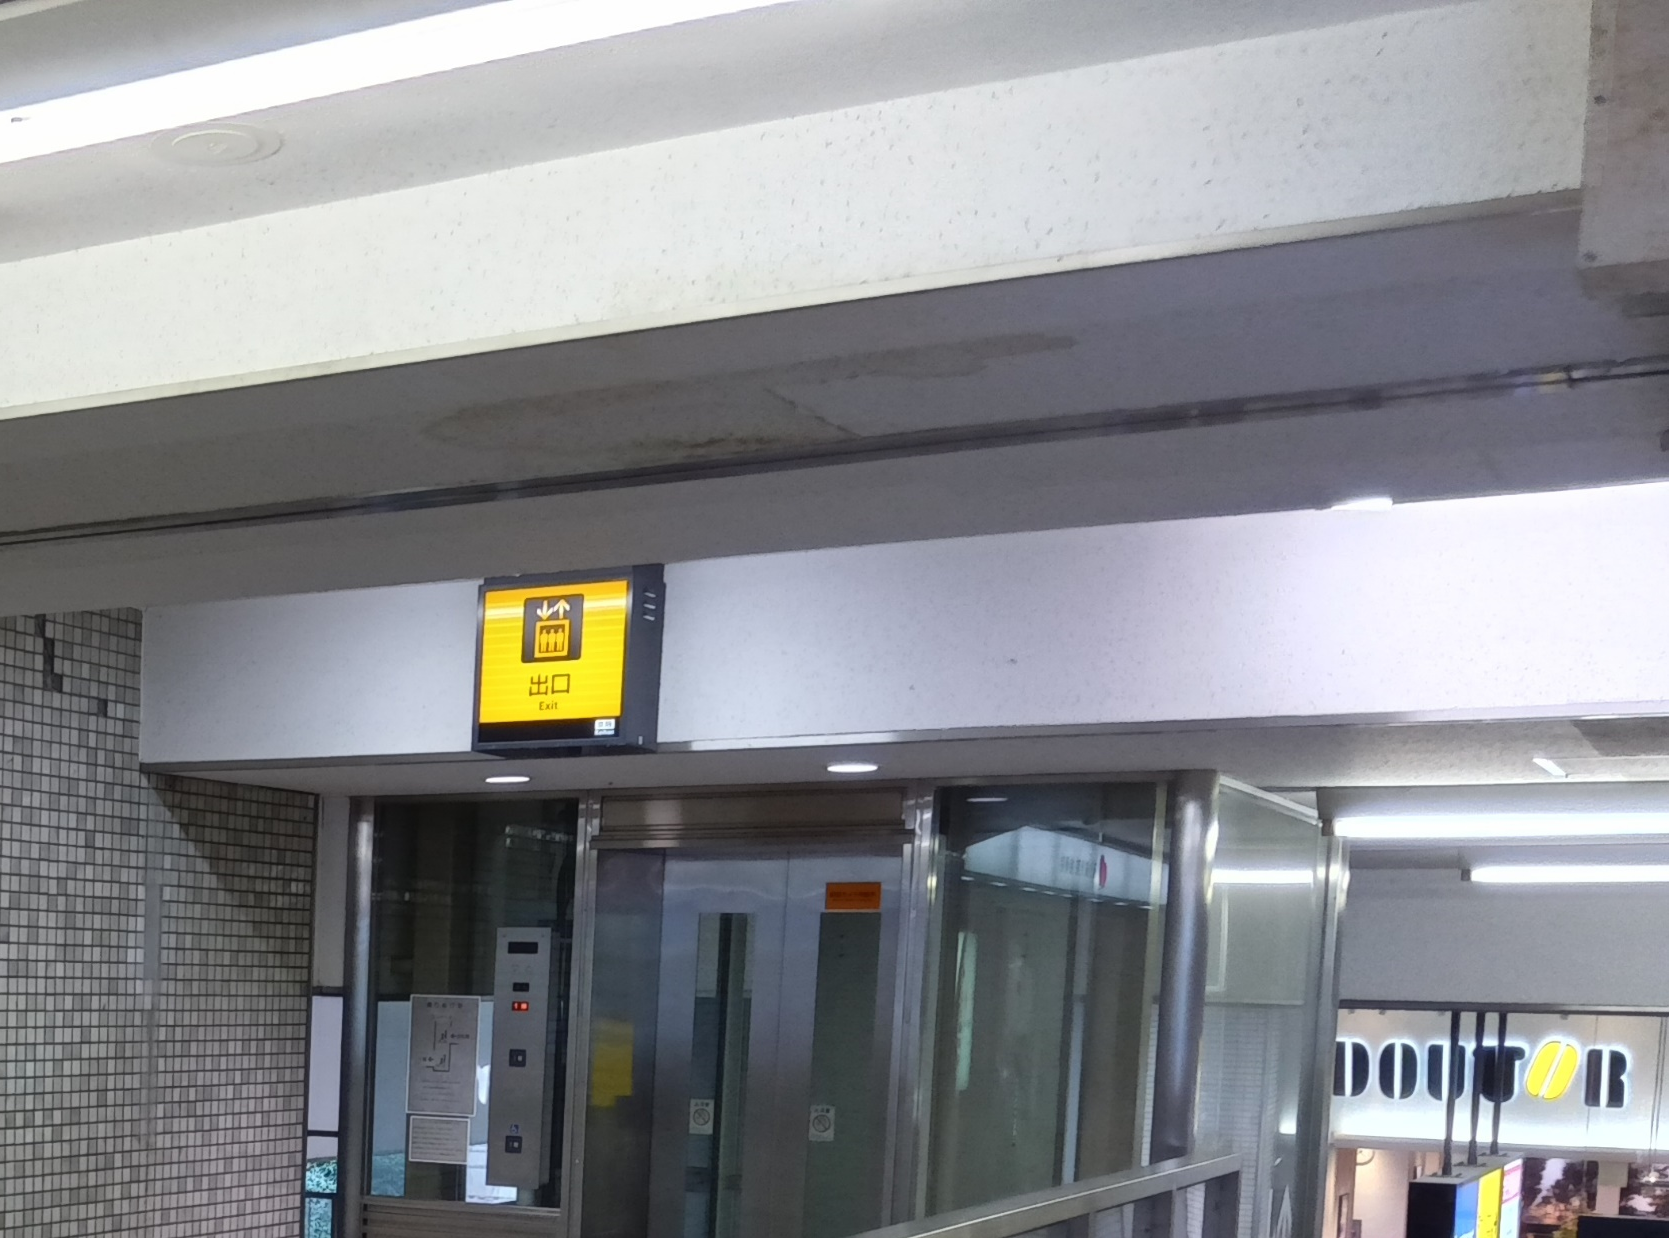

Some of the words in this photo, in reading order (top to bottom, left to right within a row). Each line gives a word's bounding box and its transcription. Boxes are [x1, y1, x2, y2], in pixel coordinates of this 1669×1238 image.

[529, 673, 570, 696] 出口
[539, 701, 558, 711] Exit
[1333, 1040, 1629, 1108] DOUTOR
